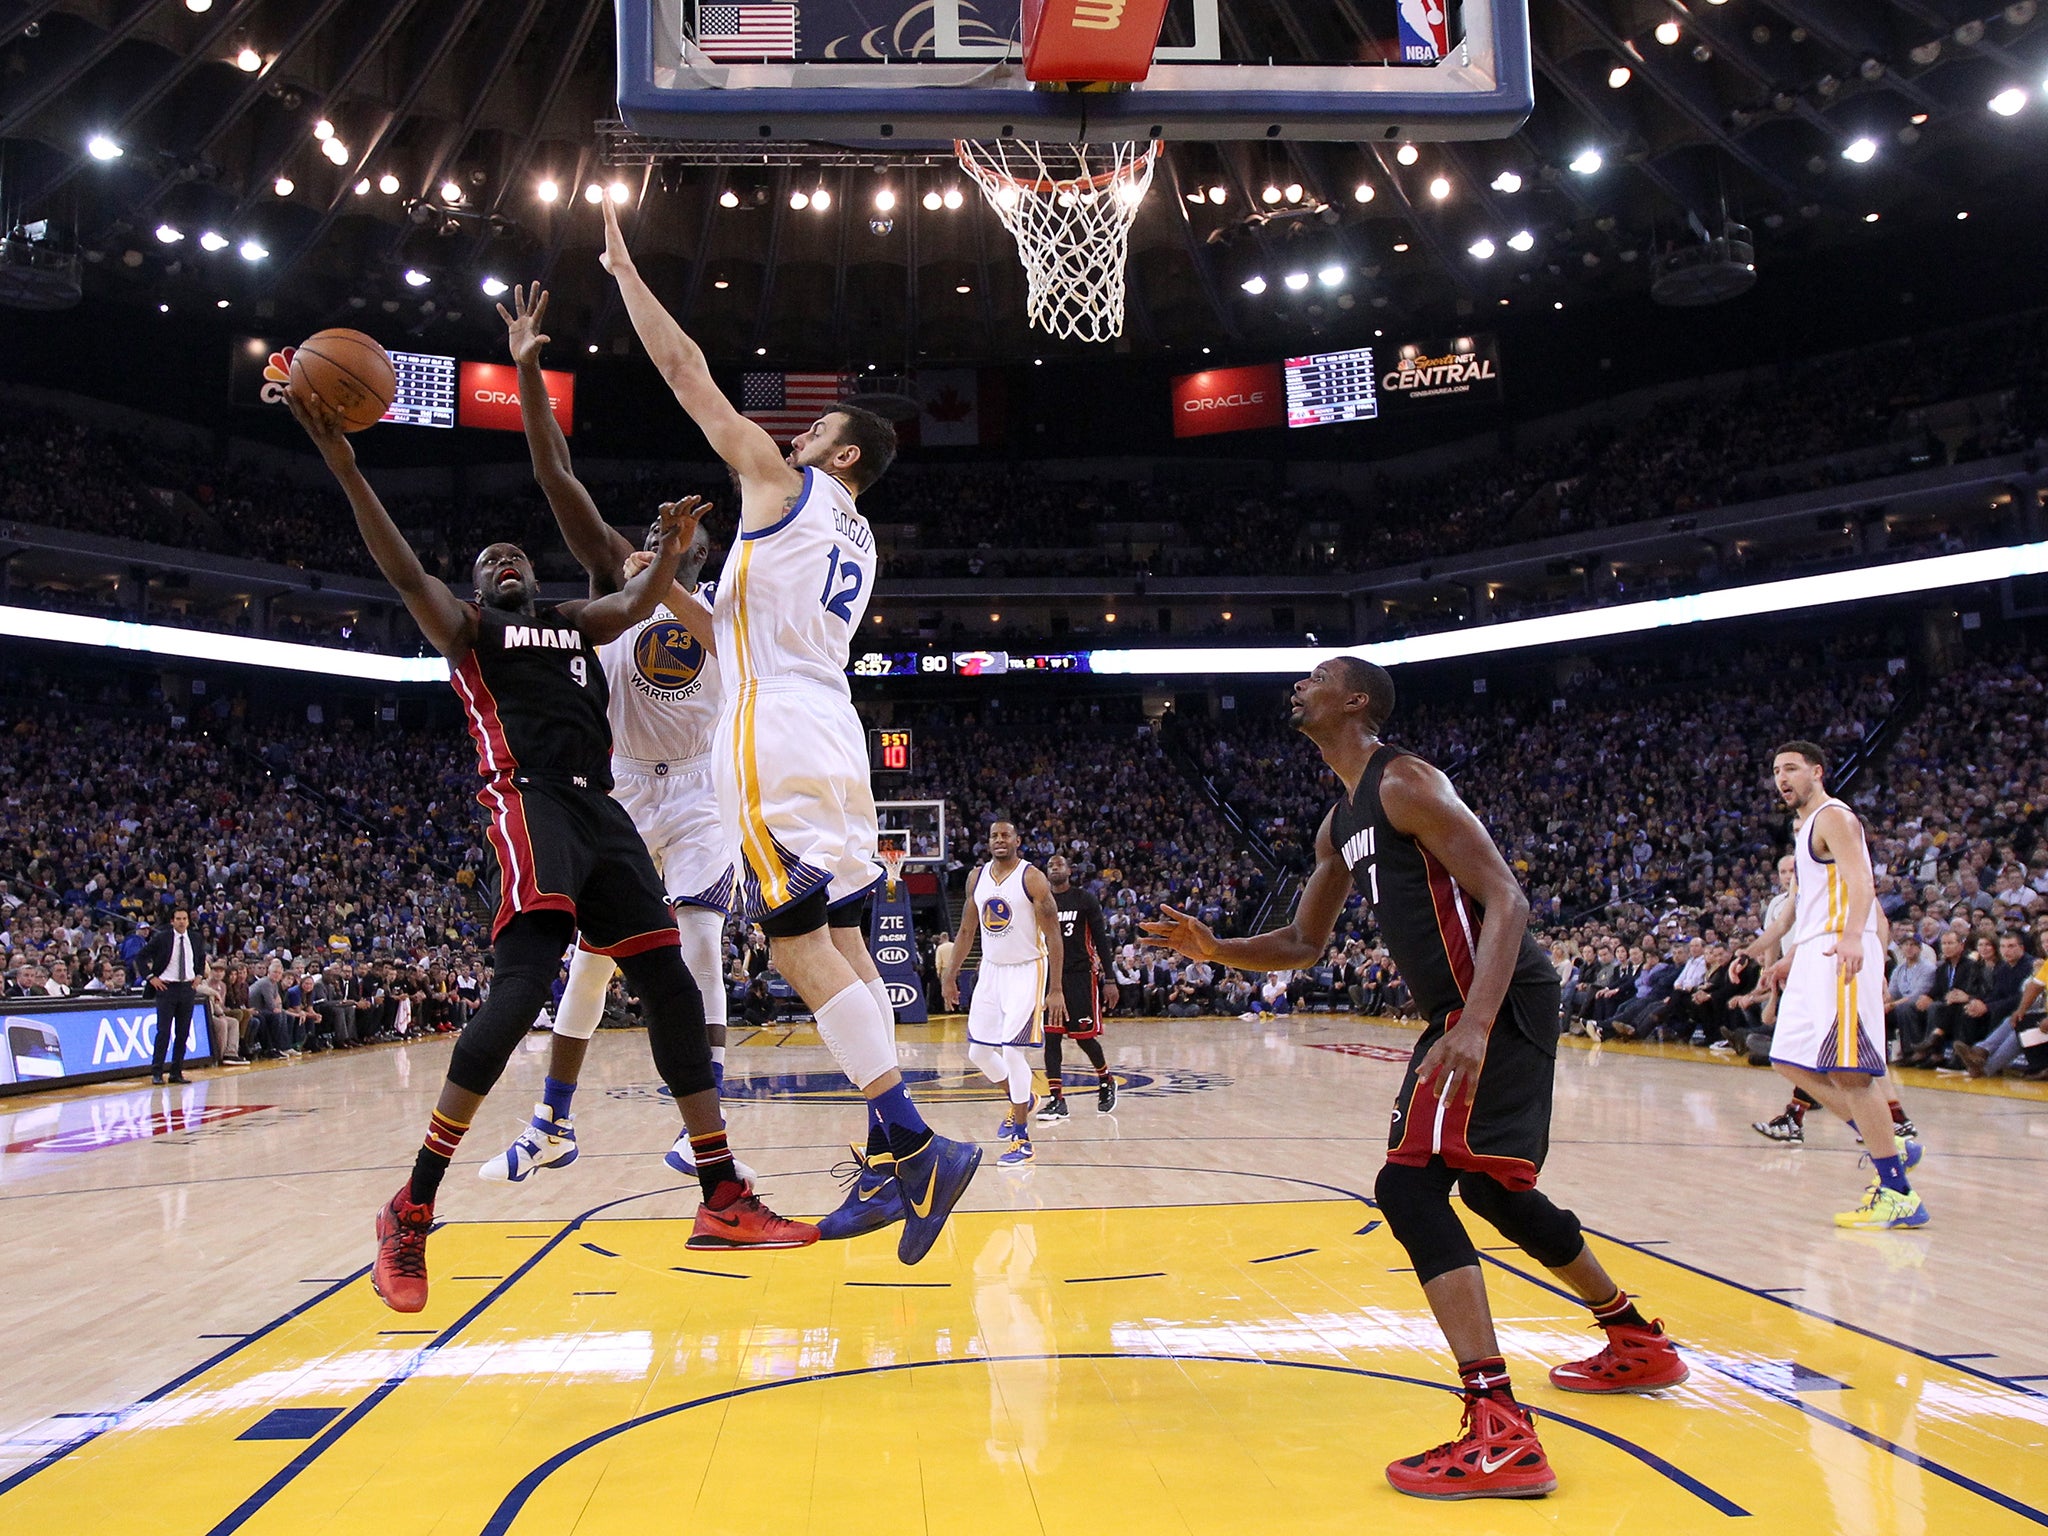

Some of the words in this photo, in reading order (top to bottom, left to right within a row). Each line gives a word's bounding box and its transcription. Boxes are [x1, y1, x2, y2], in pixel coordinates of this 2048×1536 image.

[1405, 45, 1434, 61] NBA
[1382, 360, 1496, 391] CENTRAL
[474, 390, 558, 410] ORAE
[1183, 391, 1265, 412] ORACLE
[832, 507, 874, 554] BOGUT
[820, 543, 863, 625] 12
[637, 612, 677, 630] GOLDE
[504, 625, 582, 651] MIAM
[665, 629, 694, 650] 23
[862, 653, 883, 662] 4TH
[922, 655, 948, 672] 90
[570, 655, 588, 688] 9
[854, 660, 892, 675] 3:57
[630, 673, 702, 703] WARRIORS
[881, 733, 908, 746] 3:57
[884, 745, 907, 768] 10
[1367, 863, 1380, 905] 1
[997, 903, 1005, 914] 9
[1057, 910, 1078, 922] AMI
[880, 915, 905, 930] ZTE
[1063, 922, 1075, 937] 3
[888, 933, 907, 942] CSN
[881, 950, 905, 961] KIA
